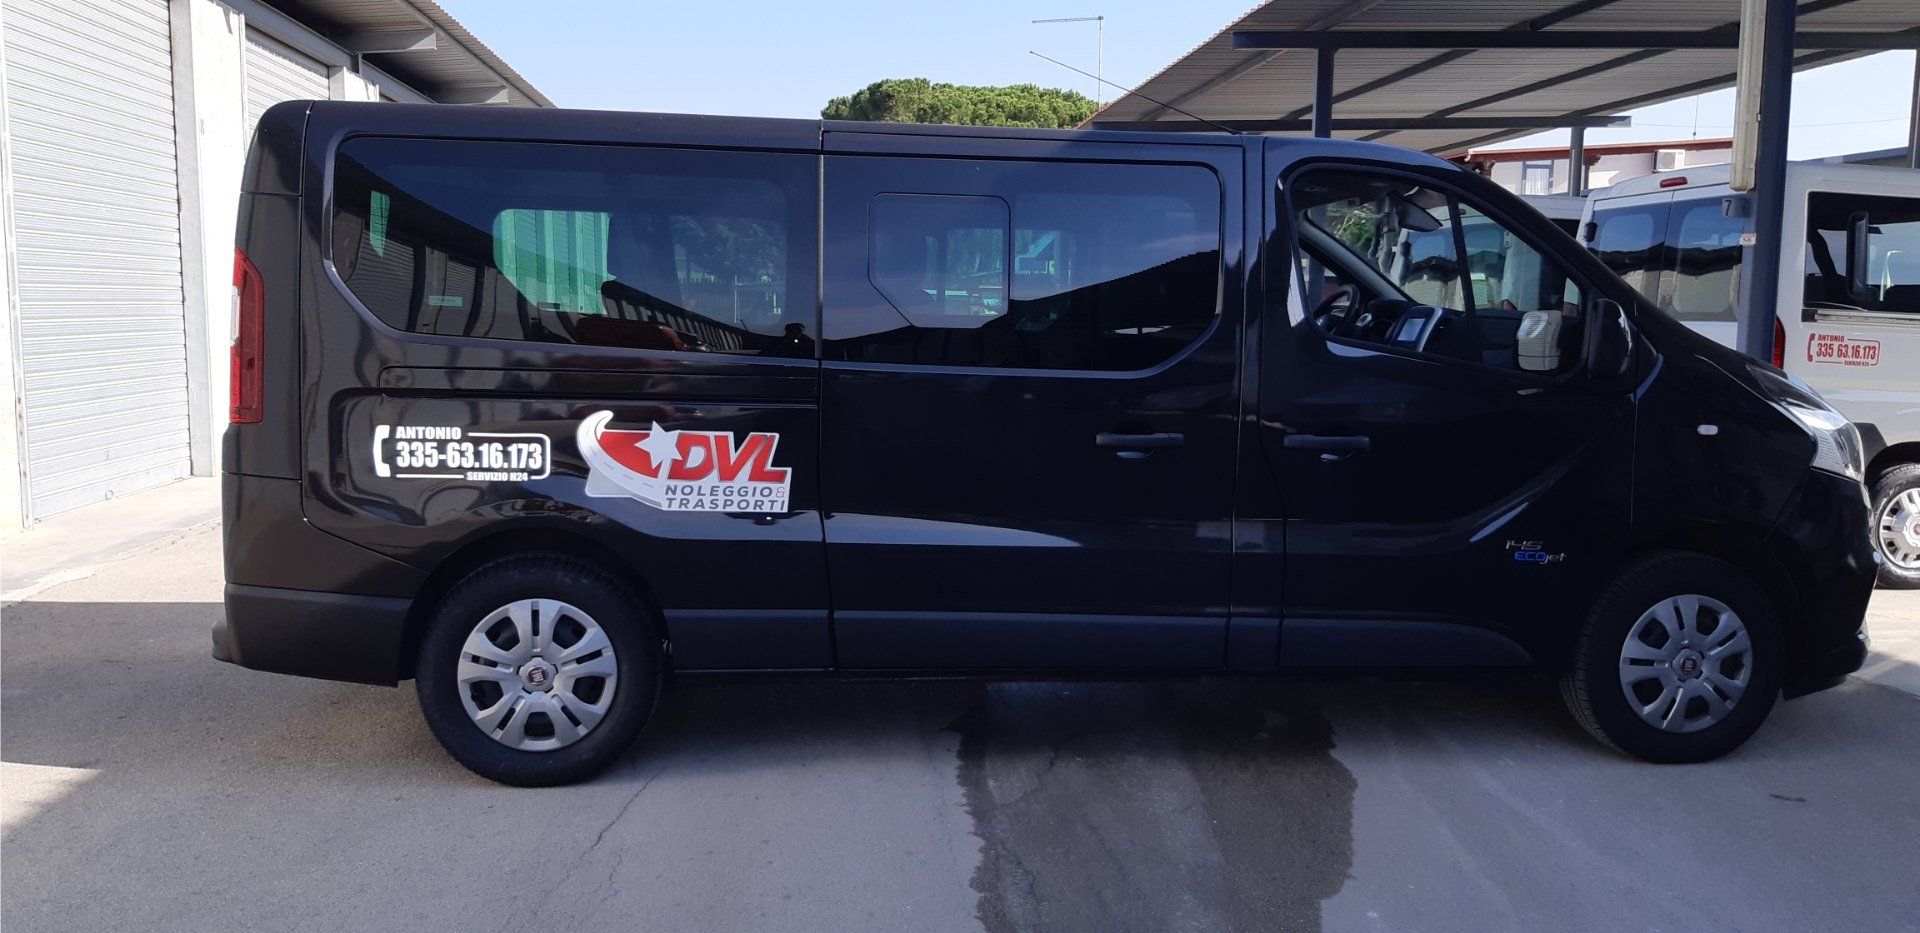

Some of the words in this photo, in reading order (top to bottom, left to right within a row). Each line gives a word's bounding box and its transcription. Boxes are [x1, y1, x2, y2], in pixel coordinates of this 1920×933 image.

[1724, 199, 1732, 216] 7
[1817, 334, 1845, 342] ANTONIO
[1816, 343, 1834, 357] 335
[1837, 344, 1877, 360] 63.16.173
[396, 426, 462, 440] ANTONIO
[396, 441, 543, 469] 335-63.16.173
[667, 432, 788, 484] DVL
[467, 472, 508, 481] SERVIZIO
[510, 472, 528, 482] H24
[666, 498, 785, 511] TRASPORTI
